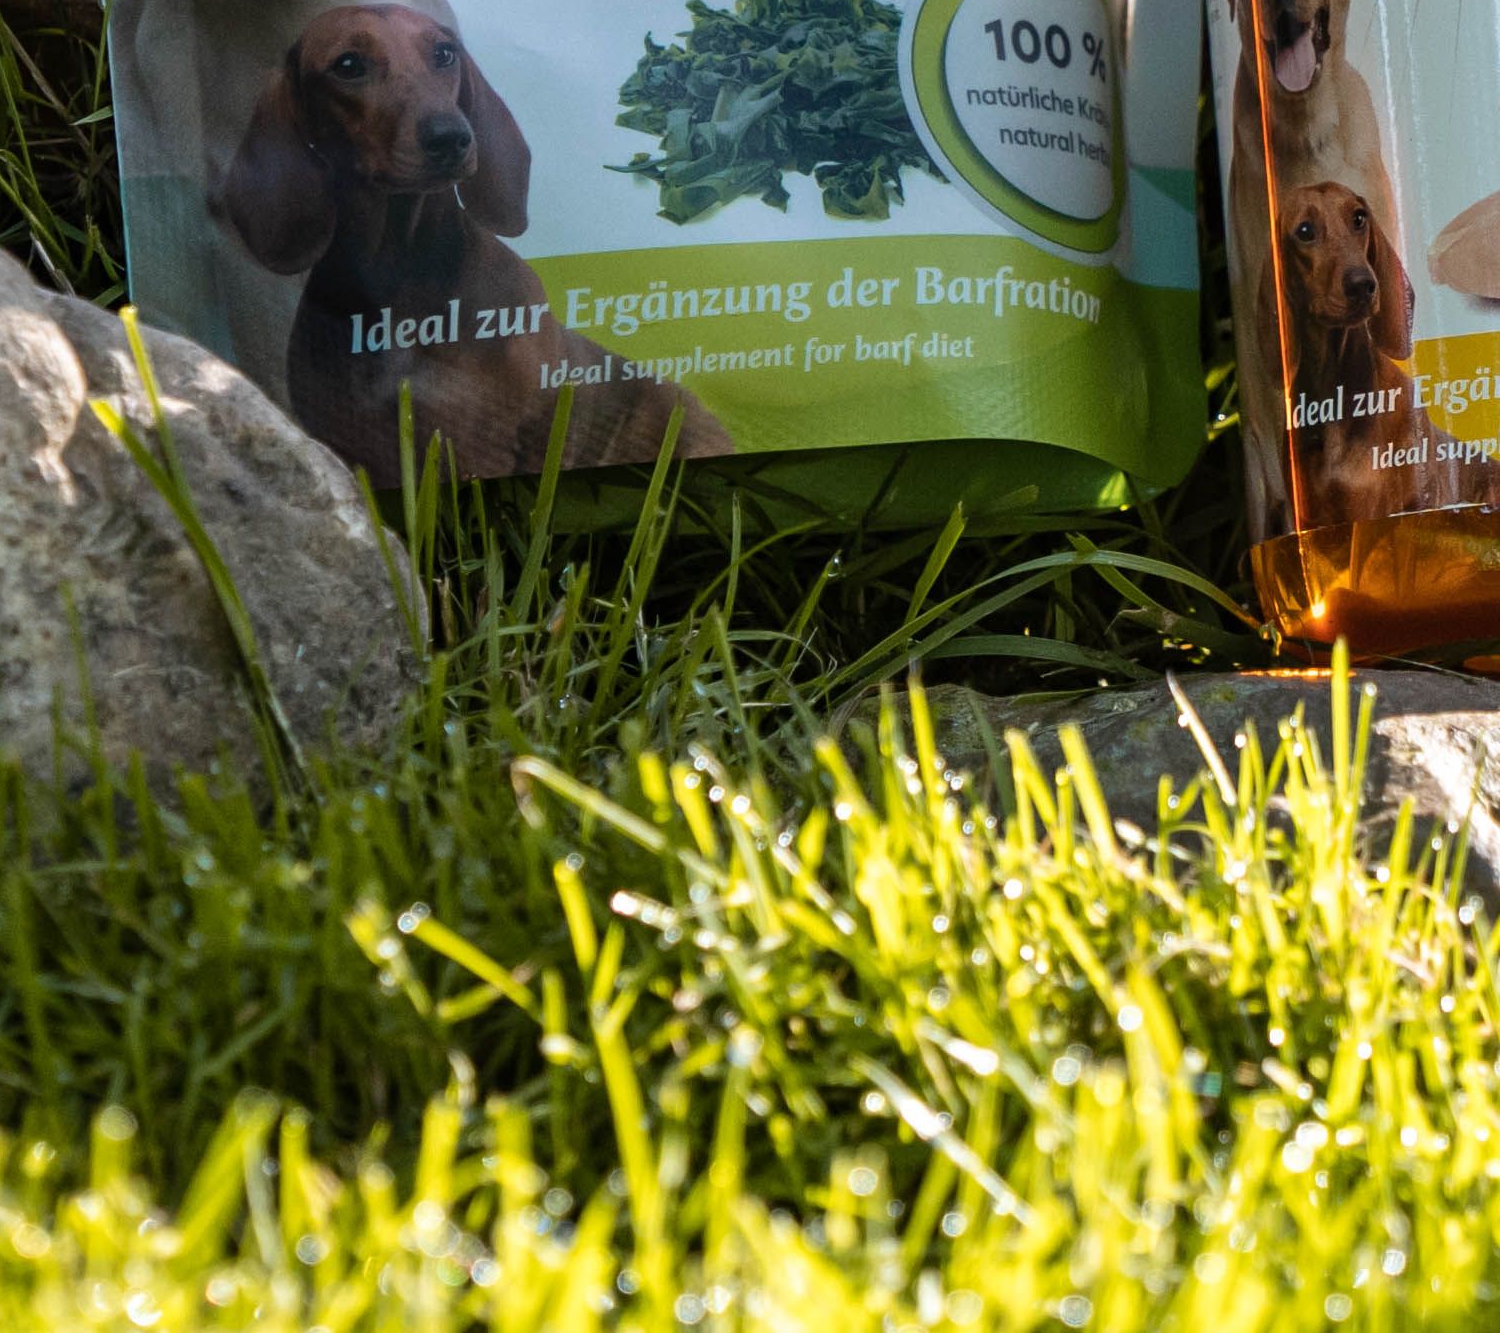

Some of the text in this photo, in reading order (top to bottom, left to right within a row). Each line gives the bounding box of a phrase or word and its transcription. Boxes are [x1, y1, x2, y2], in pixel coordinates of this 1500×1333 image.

[984, 18, 1107, 83] 100 %
[966, 85, 1074, 116] natürliche
[999, 125, 1075, 155] natural
[349, 265, 1101, 354] Ideal zur Ergänzung der Barfration
[539, 331, 975, 389] Ideal supplement for barf diet
[1286, 385, 1345, 431] Ideal
[1352, 387, 1402, 419] zur
[1370, 441, 1428, 472] Ideal
